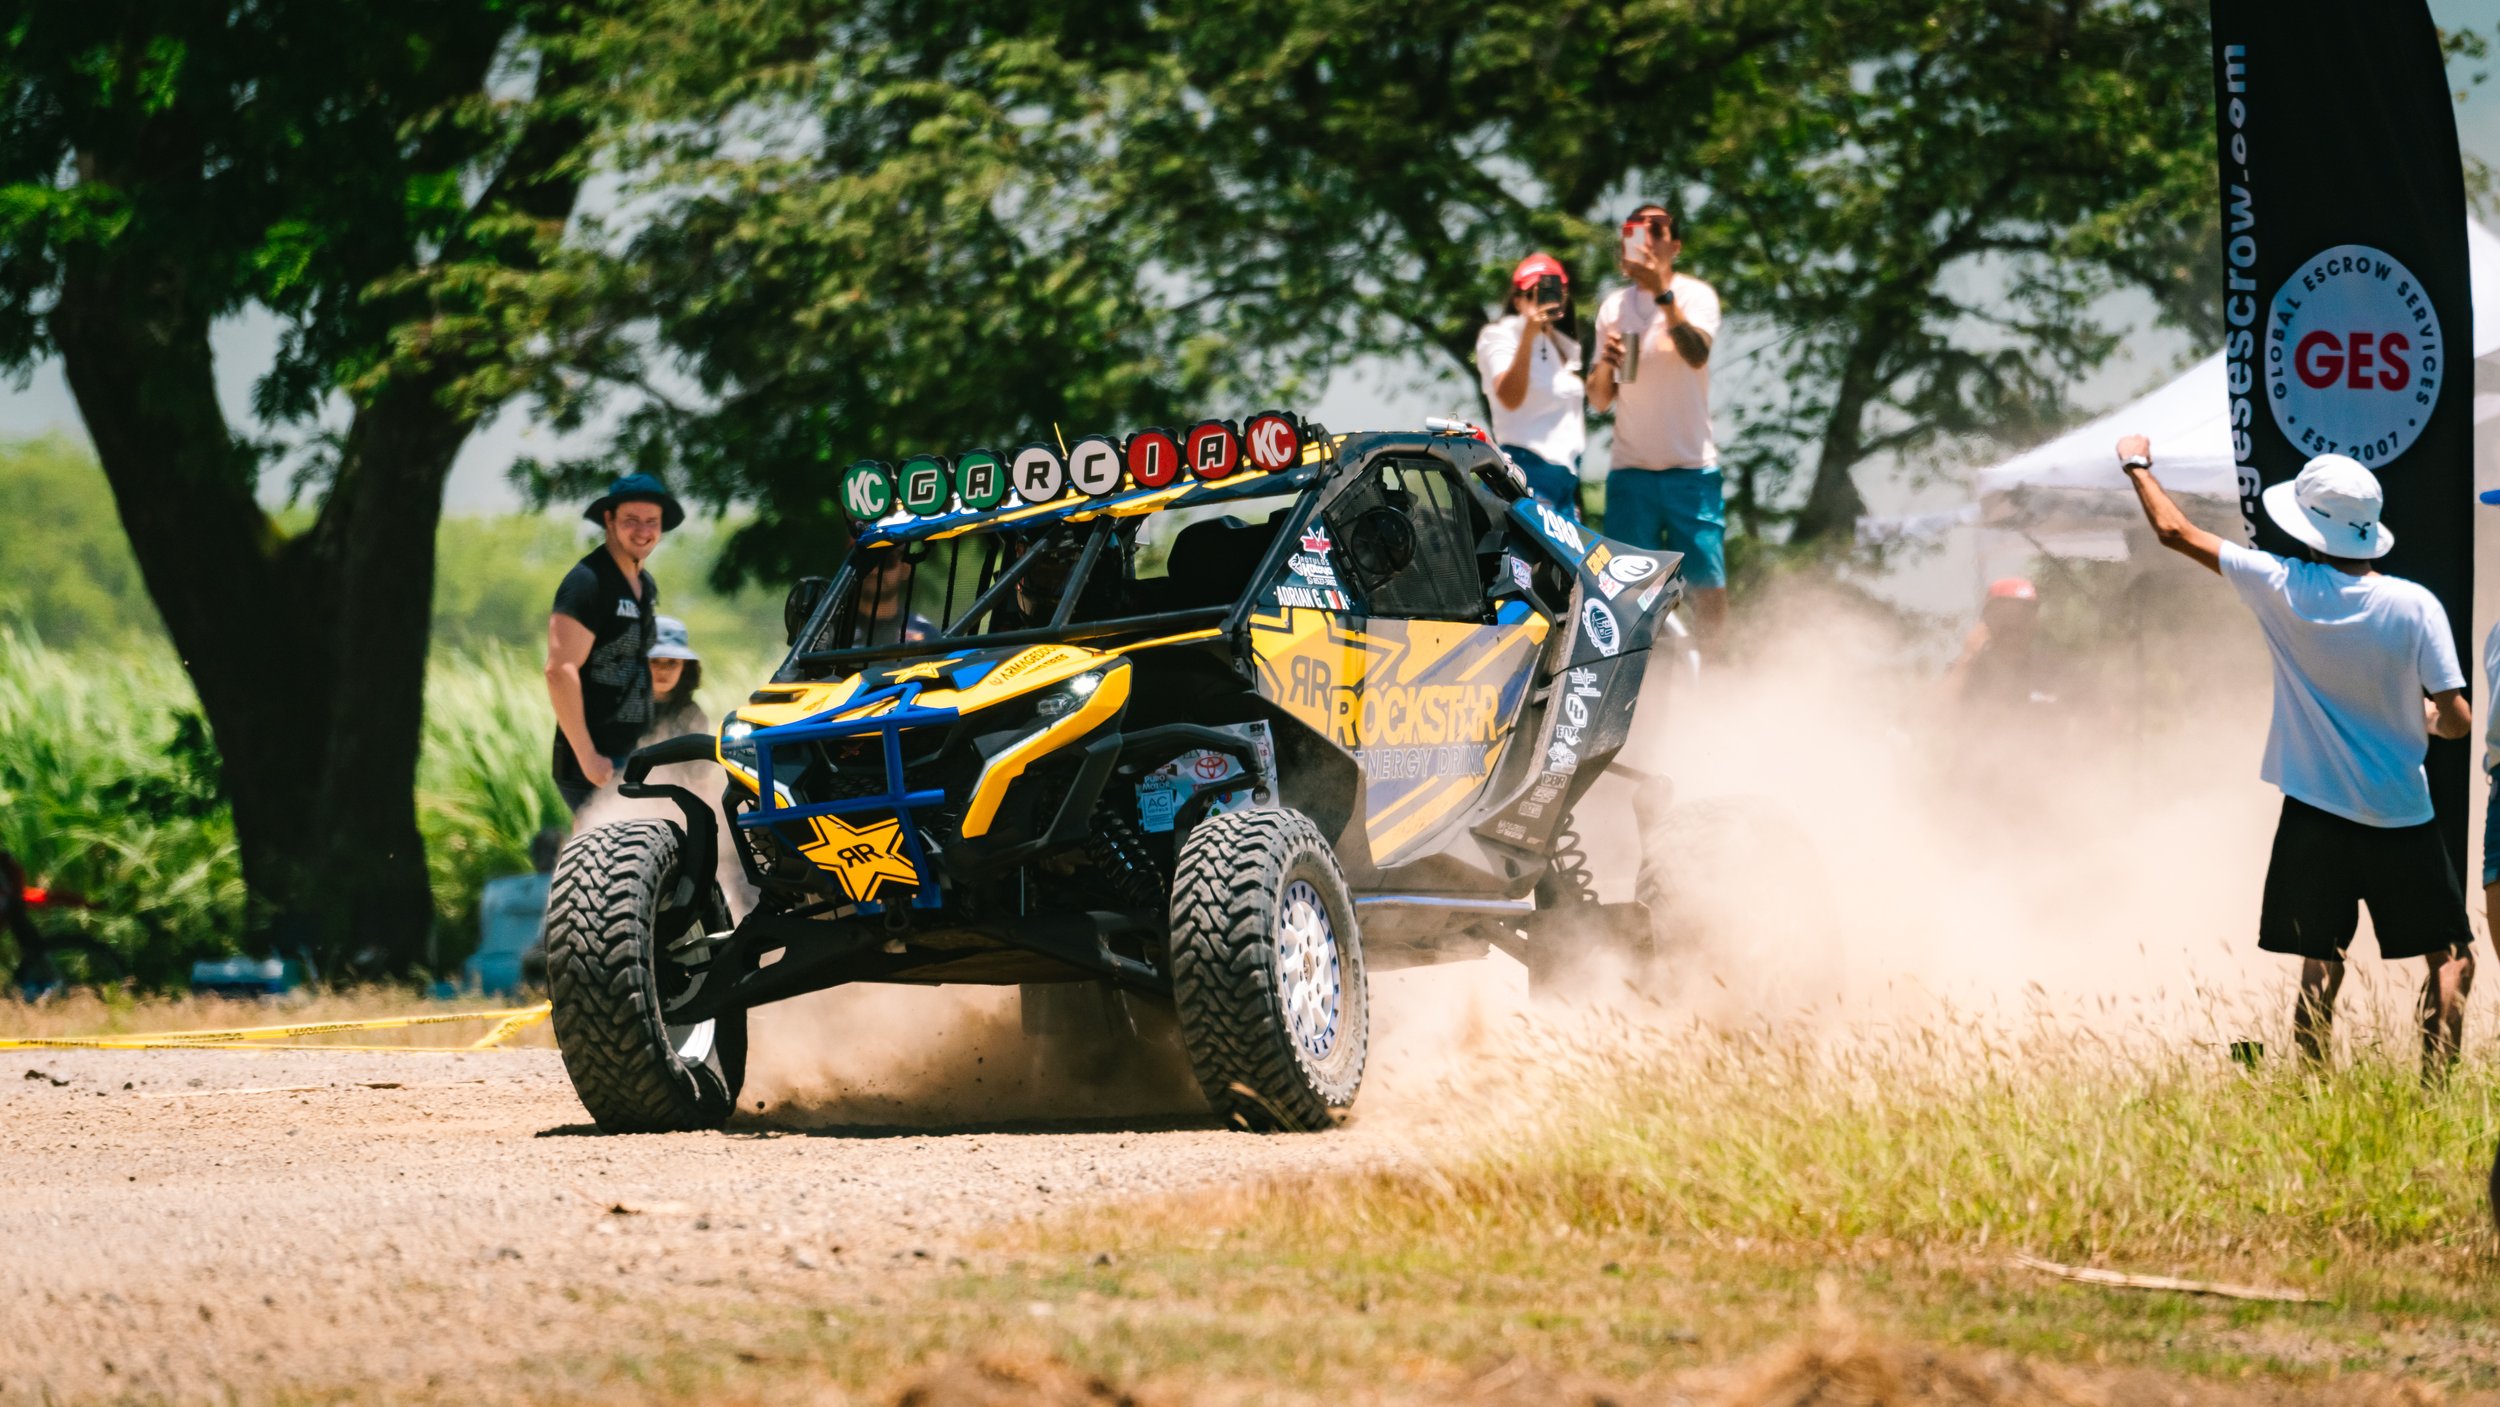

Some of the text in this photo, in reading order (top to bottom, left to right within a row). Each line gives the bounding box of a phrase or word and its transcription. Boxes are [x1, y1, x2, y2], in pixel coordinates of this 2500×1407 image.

[2270, 256, 2437, 405] GLOBAL ESCROW SERVICES
[2294, 330, 2411, 392] GES
[847, 470, 884, 516] KC
[1253, 420, 1292, 468] KC
[2301, 427, 2399, 461] EST 2007
[1276, 585, 1315, 608] ADRIAN
[1328, 684, 1499, 747] ROCKSTAR
[1438, 745, 1488, 777] DRINK
[1147, 795, 1168, 808] AC
